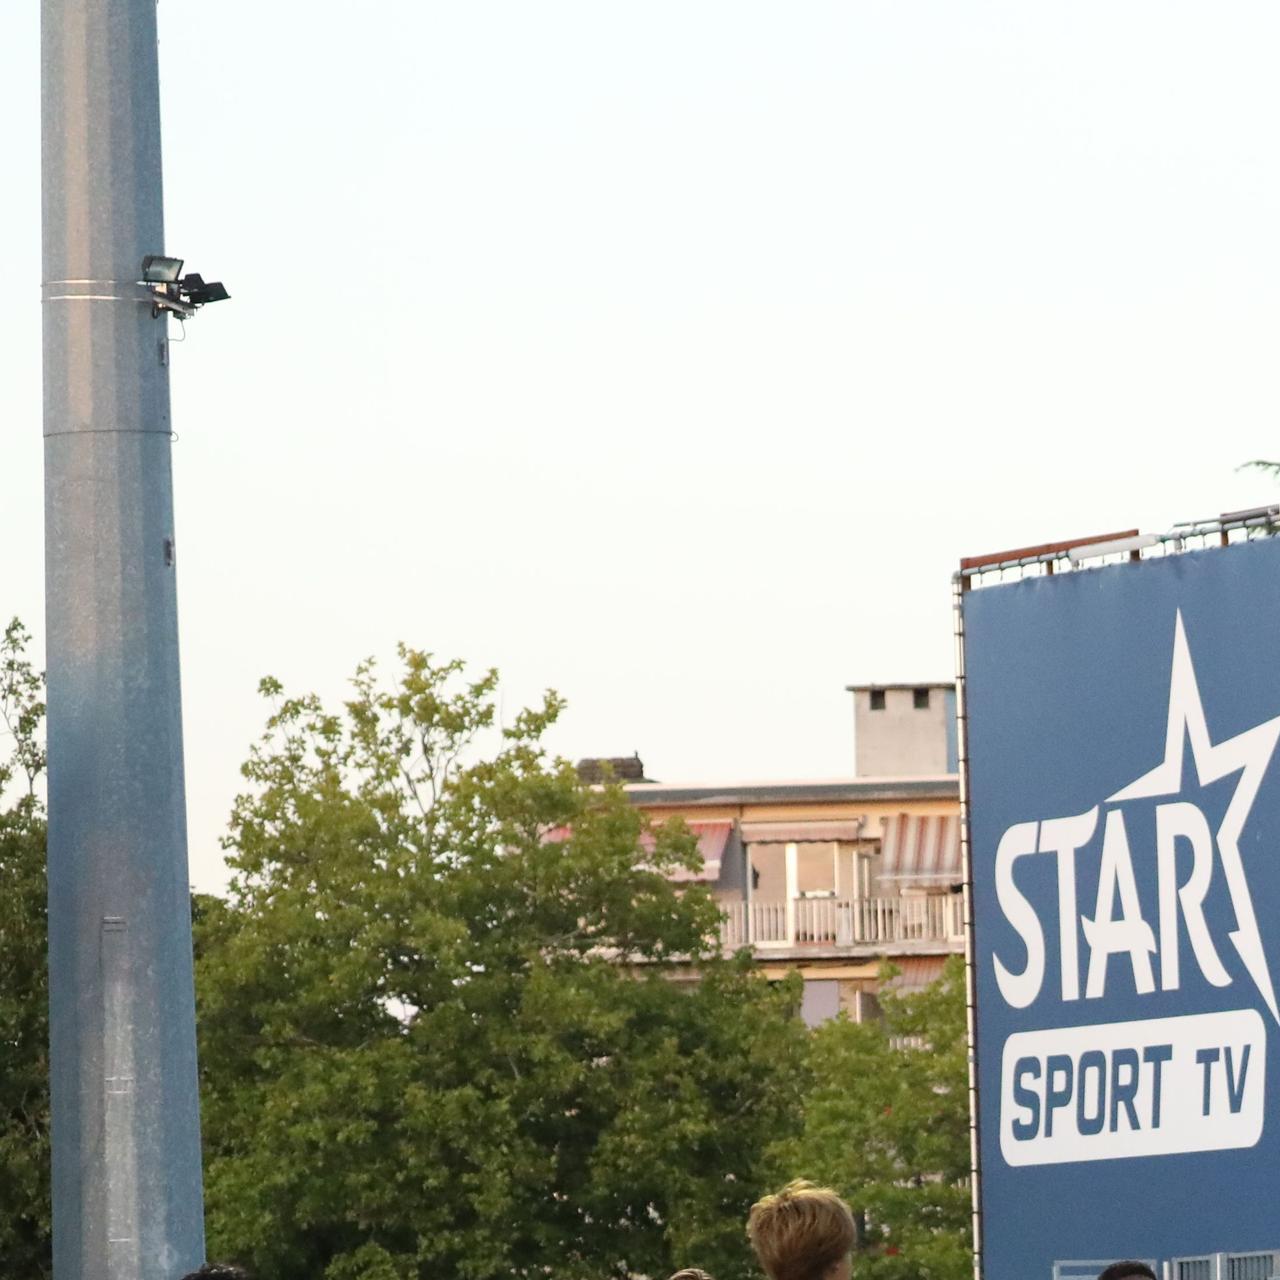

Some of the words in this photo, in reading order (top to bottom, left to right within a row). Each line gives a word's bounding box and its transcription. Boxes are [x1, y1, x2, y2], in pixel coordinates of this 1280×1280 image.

[992, 802, 1233, 1008] STAR
[1011, 1044, 1173, 1142] SPORT
[1196, 1043, 1252, 1115] TV
